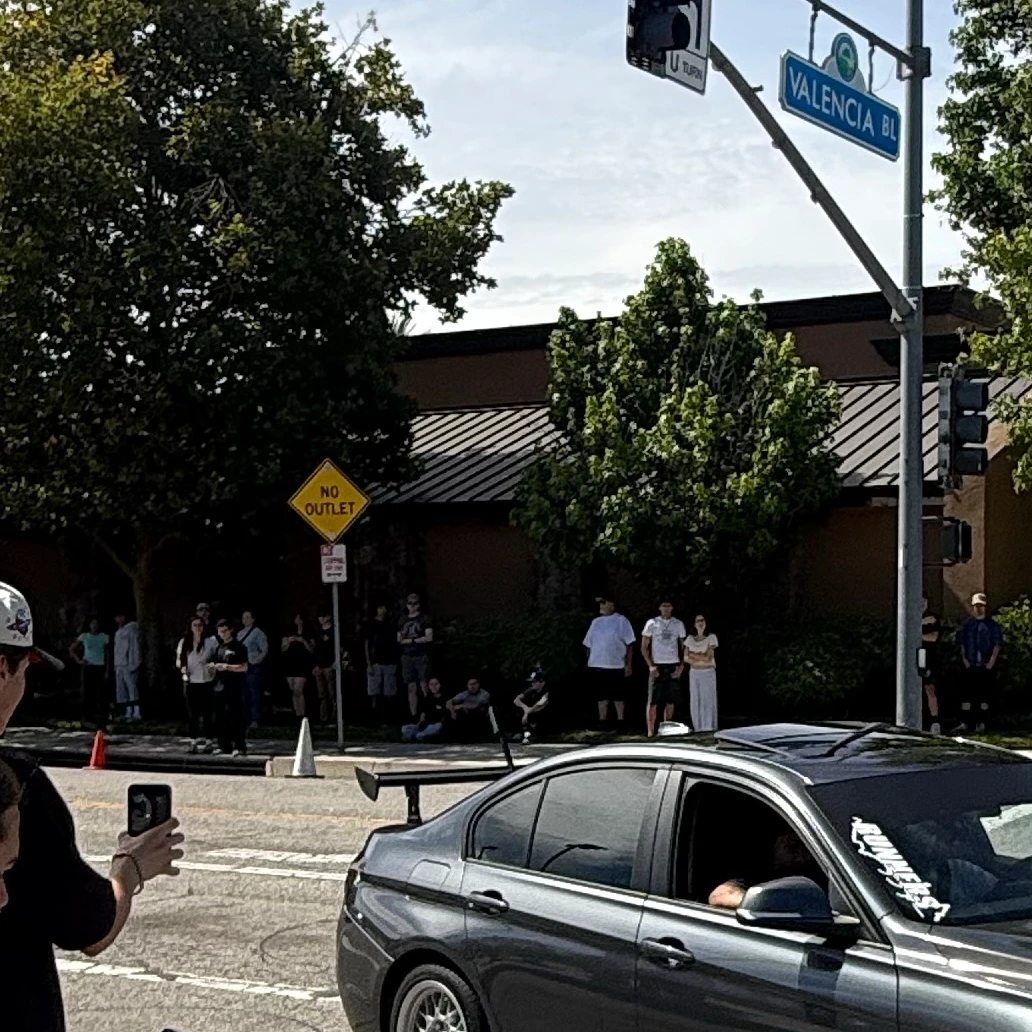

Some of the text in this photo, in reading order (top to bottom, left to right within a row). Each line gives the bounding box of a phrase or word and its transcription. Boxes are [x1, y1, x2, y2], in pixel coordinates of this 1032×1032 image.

[670, 51, 679, 73] U
[789, 66, 896, 141] VALENCIA BL
[320, 486, 339, 498] NO
[304, 502, 355, 515] OUTLET
